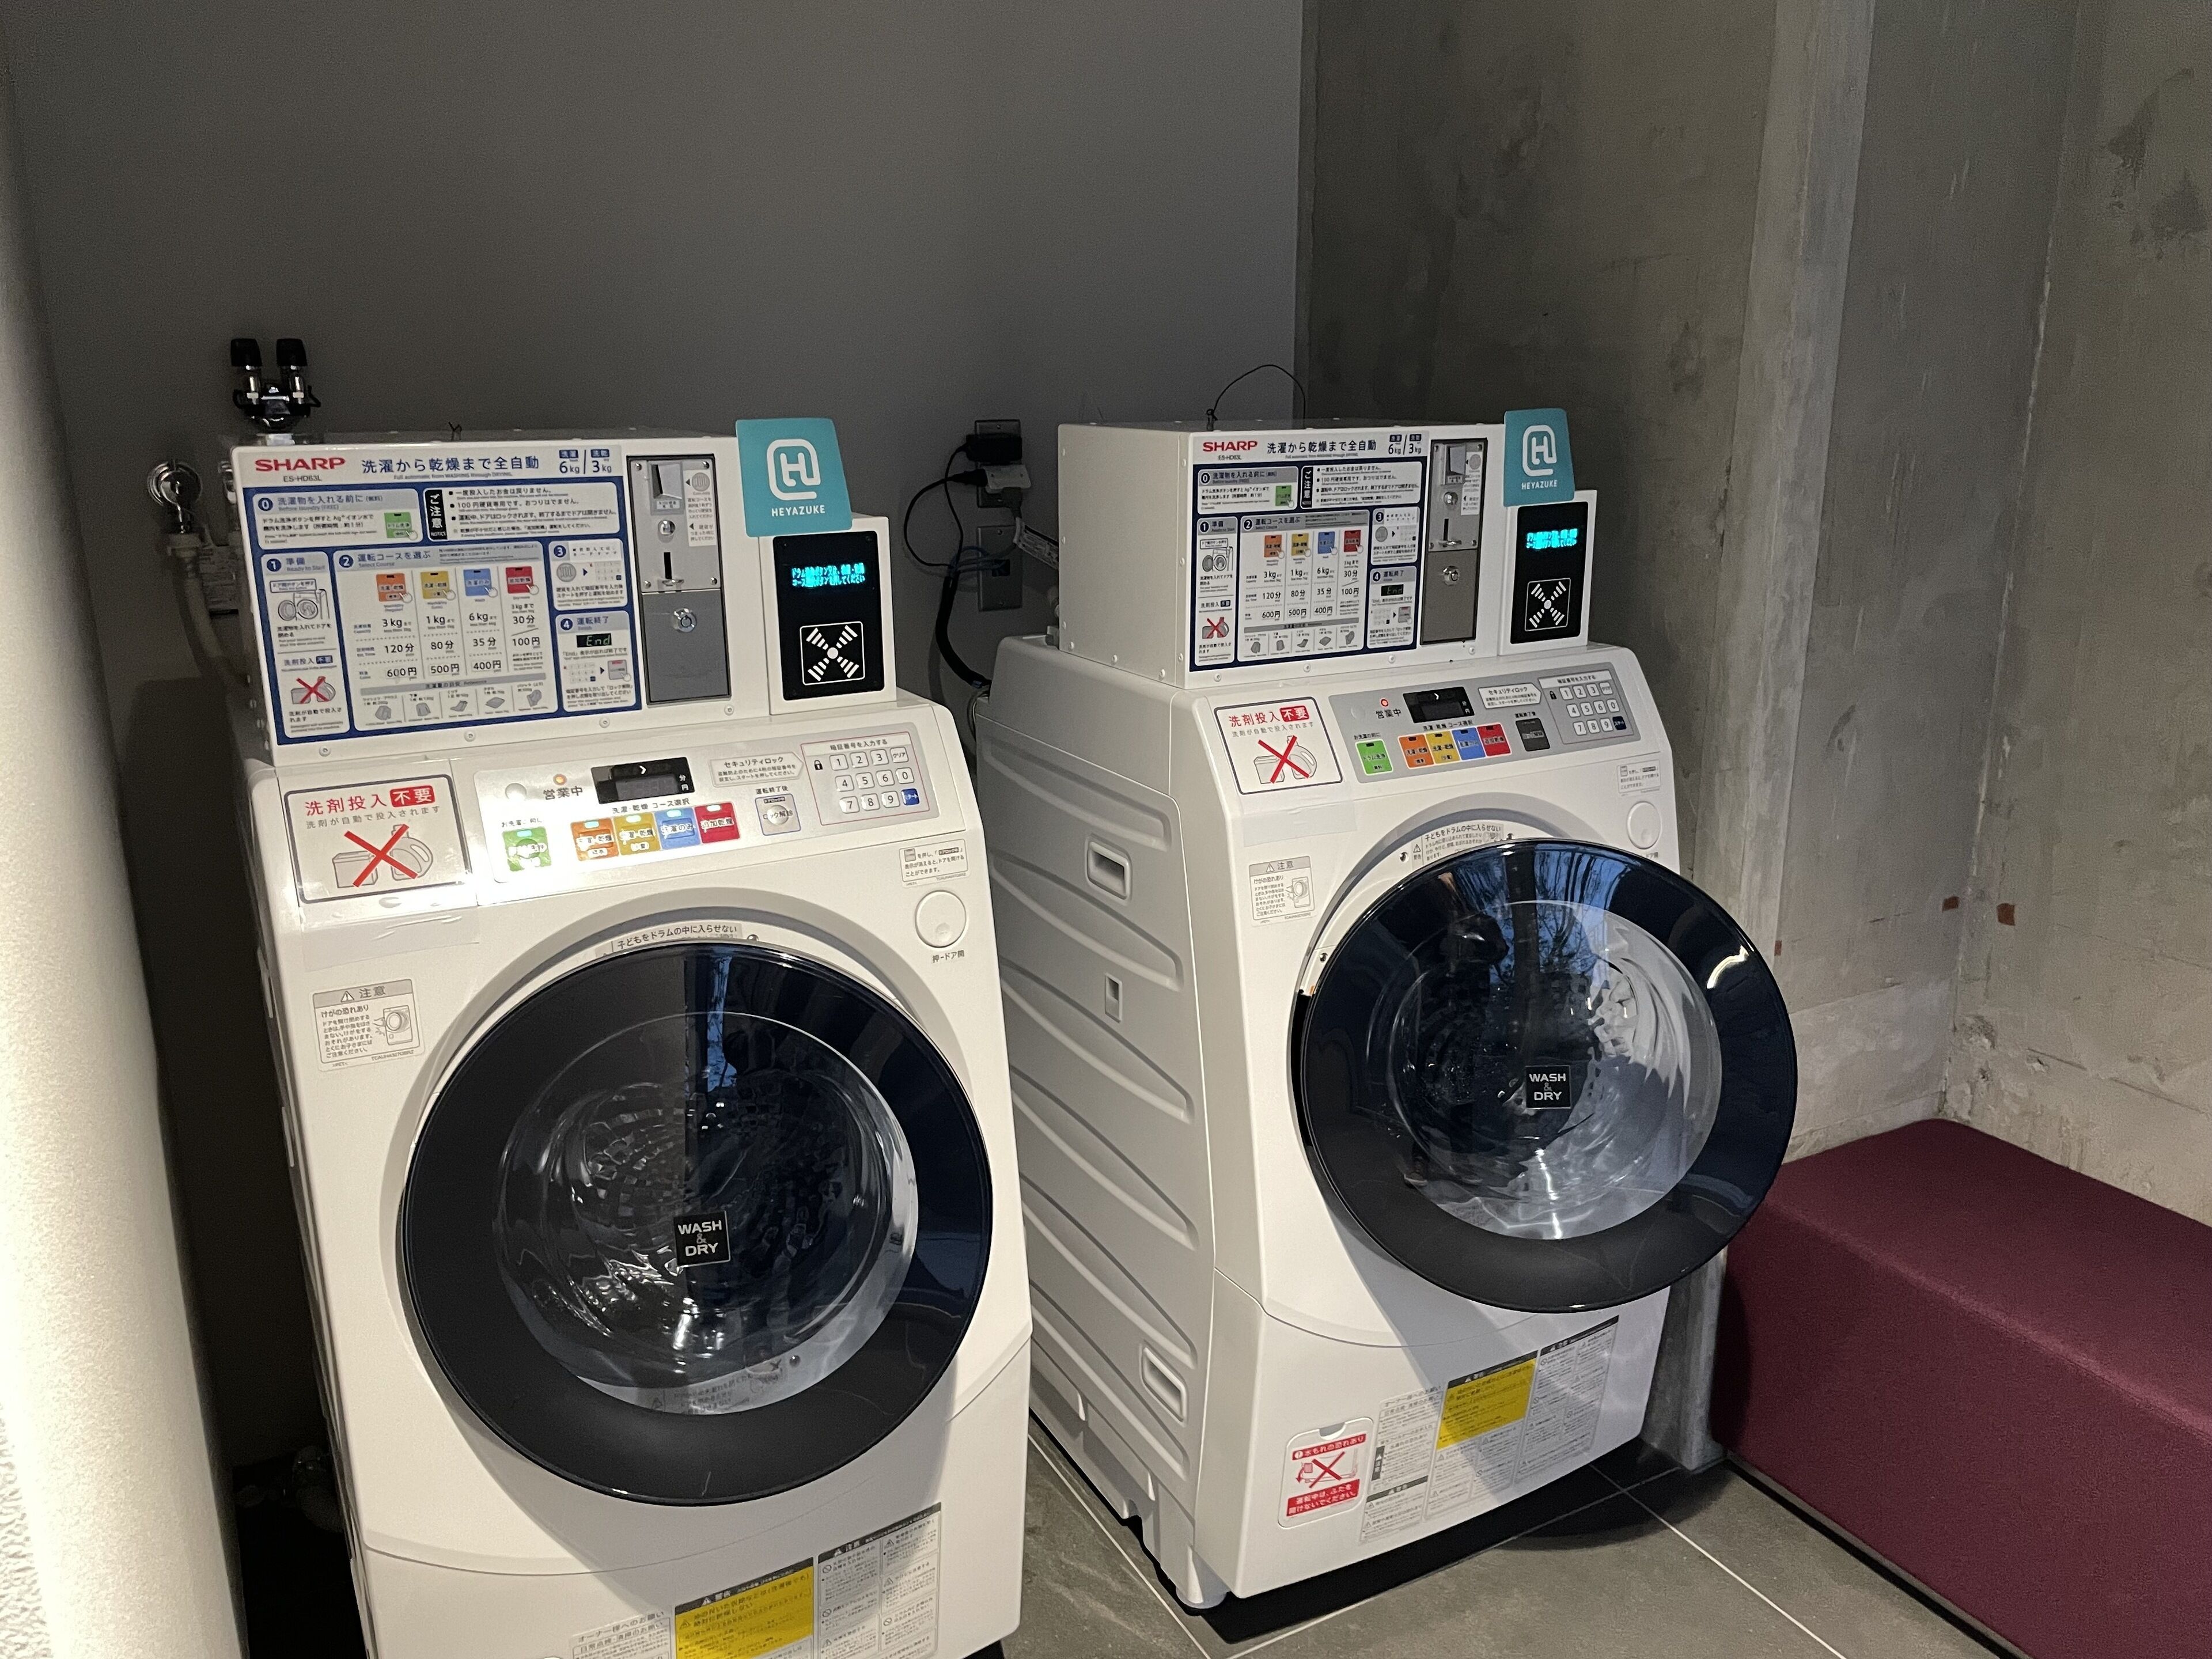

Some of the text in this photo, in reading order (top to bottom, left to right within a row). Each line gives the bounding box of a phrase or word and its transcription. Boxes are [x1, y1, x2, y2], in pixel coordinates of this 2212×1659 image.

[1203, 441, 1257, 452] SHARP
[1267, 440, 1377, 454] 洗濯から乾燥まで全自動
[255, 457, 346, 472] SHARP
[362, 456, 539, 474] 洗濯から乾燥まで全自動
[283, 475, 322, 483] ES-HD63L
[1521, 480, 1558, 490] HEYAZUKE
[278, 494, 363, 506] 洗濯物を入れる前に
[430, 494, 444, 529] ご注意
[771, 505, 825, 517] HEYAZUKE
[342, 557, 350, 567] 2
[358, 551, 431, 562] 運転コースを選ぶ
[1344, 570, 1358, 578] 30分
[1263, 591, 1281, 599] 120分
[1290, 589, 1305, 597] 80分
[1317, 587, 1331, 595] 35分
[1342, 588, 1359, 596] 100円
[469, 613, 475, 621] 6
[477, 613, 488, 622] kg
[1262, 611, 1281, 619] 600円
[1288, 608, 1307, 616] 500円
[382, 619, 388, 627] 3
[390, 619, 402, 628] kg
[433, 616, 445, 624] kg
[513, 615, 535, 624] 30分
[431, 641, 454, 650] 80分
[473, 637, 496, 647] 35分
[513, 637, 540, 646] 100円
[586, 634, 611, 646] End
[385, 643, 414, 654] 120分
[430, 664, 460, 673] 500円
[473, 660, 502, 670] 400円
[387, 667, 417, 677] 600円
[1488, 687, 1527, 696] セキュリティロック
[1229, 707, 1308, 728] 洗剤投入 不要
[1376, 708, 1402, 719] 営業中
[1232, 721, 1314, 738] 洗剤が自動で投入されます
[830, 738, 888, 751] 暗証番号を入力する
[724, 756, 783, 768] セキュリティロック
[856, 756, 863, 764] 2
[877, 753, 883, 762] 3
[842, 771, 908, 787] 4 5 6 0
[543, 786, 583, 800] 営業中
[755, 785, 789, 794] 運転終了後
[305, 787, 433, 816] 洗剤投入 不要
[652, 798, 690, 809] コース選択
[847, 796, 894, 809] 7 8 9
[306, 806, 440, 830] 洗剤が自動で投入されます
[1425, 824, 1502, 841] 子どもをドラムの中に入らせない
[618, 925, 737, 950] 子どもをドラムの中に入らせない
[359, 986, 387, 999] 注意
[321, 1005, 369, 1018] けがの恐れあり
[1529, 1073, 1566, 1082] WASH
[1543, 1082, 1553, 1092] &
[1533, 1091, 1562, 1101] DRY
[678, 1220, 722, 1234] WASH
[696, 1233, 708, 1244] &
[685, 1243, 718, 1256] DRY
